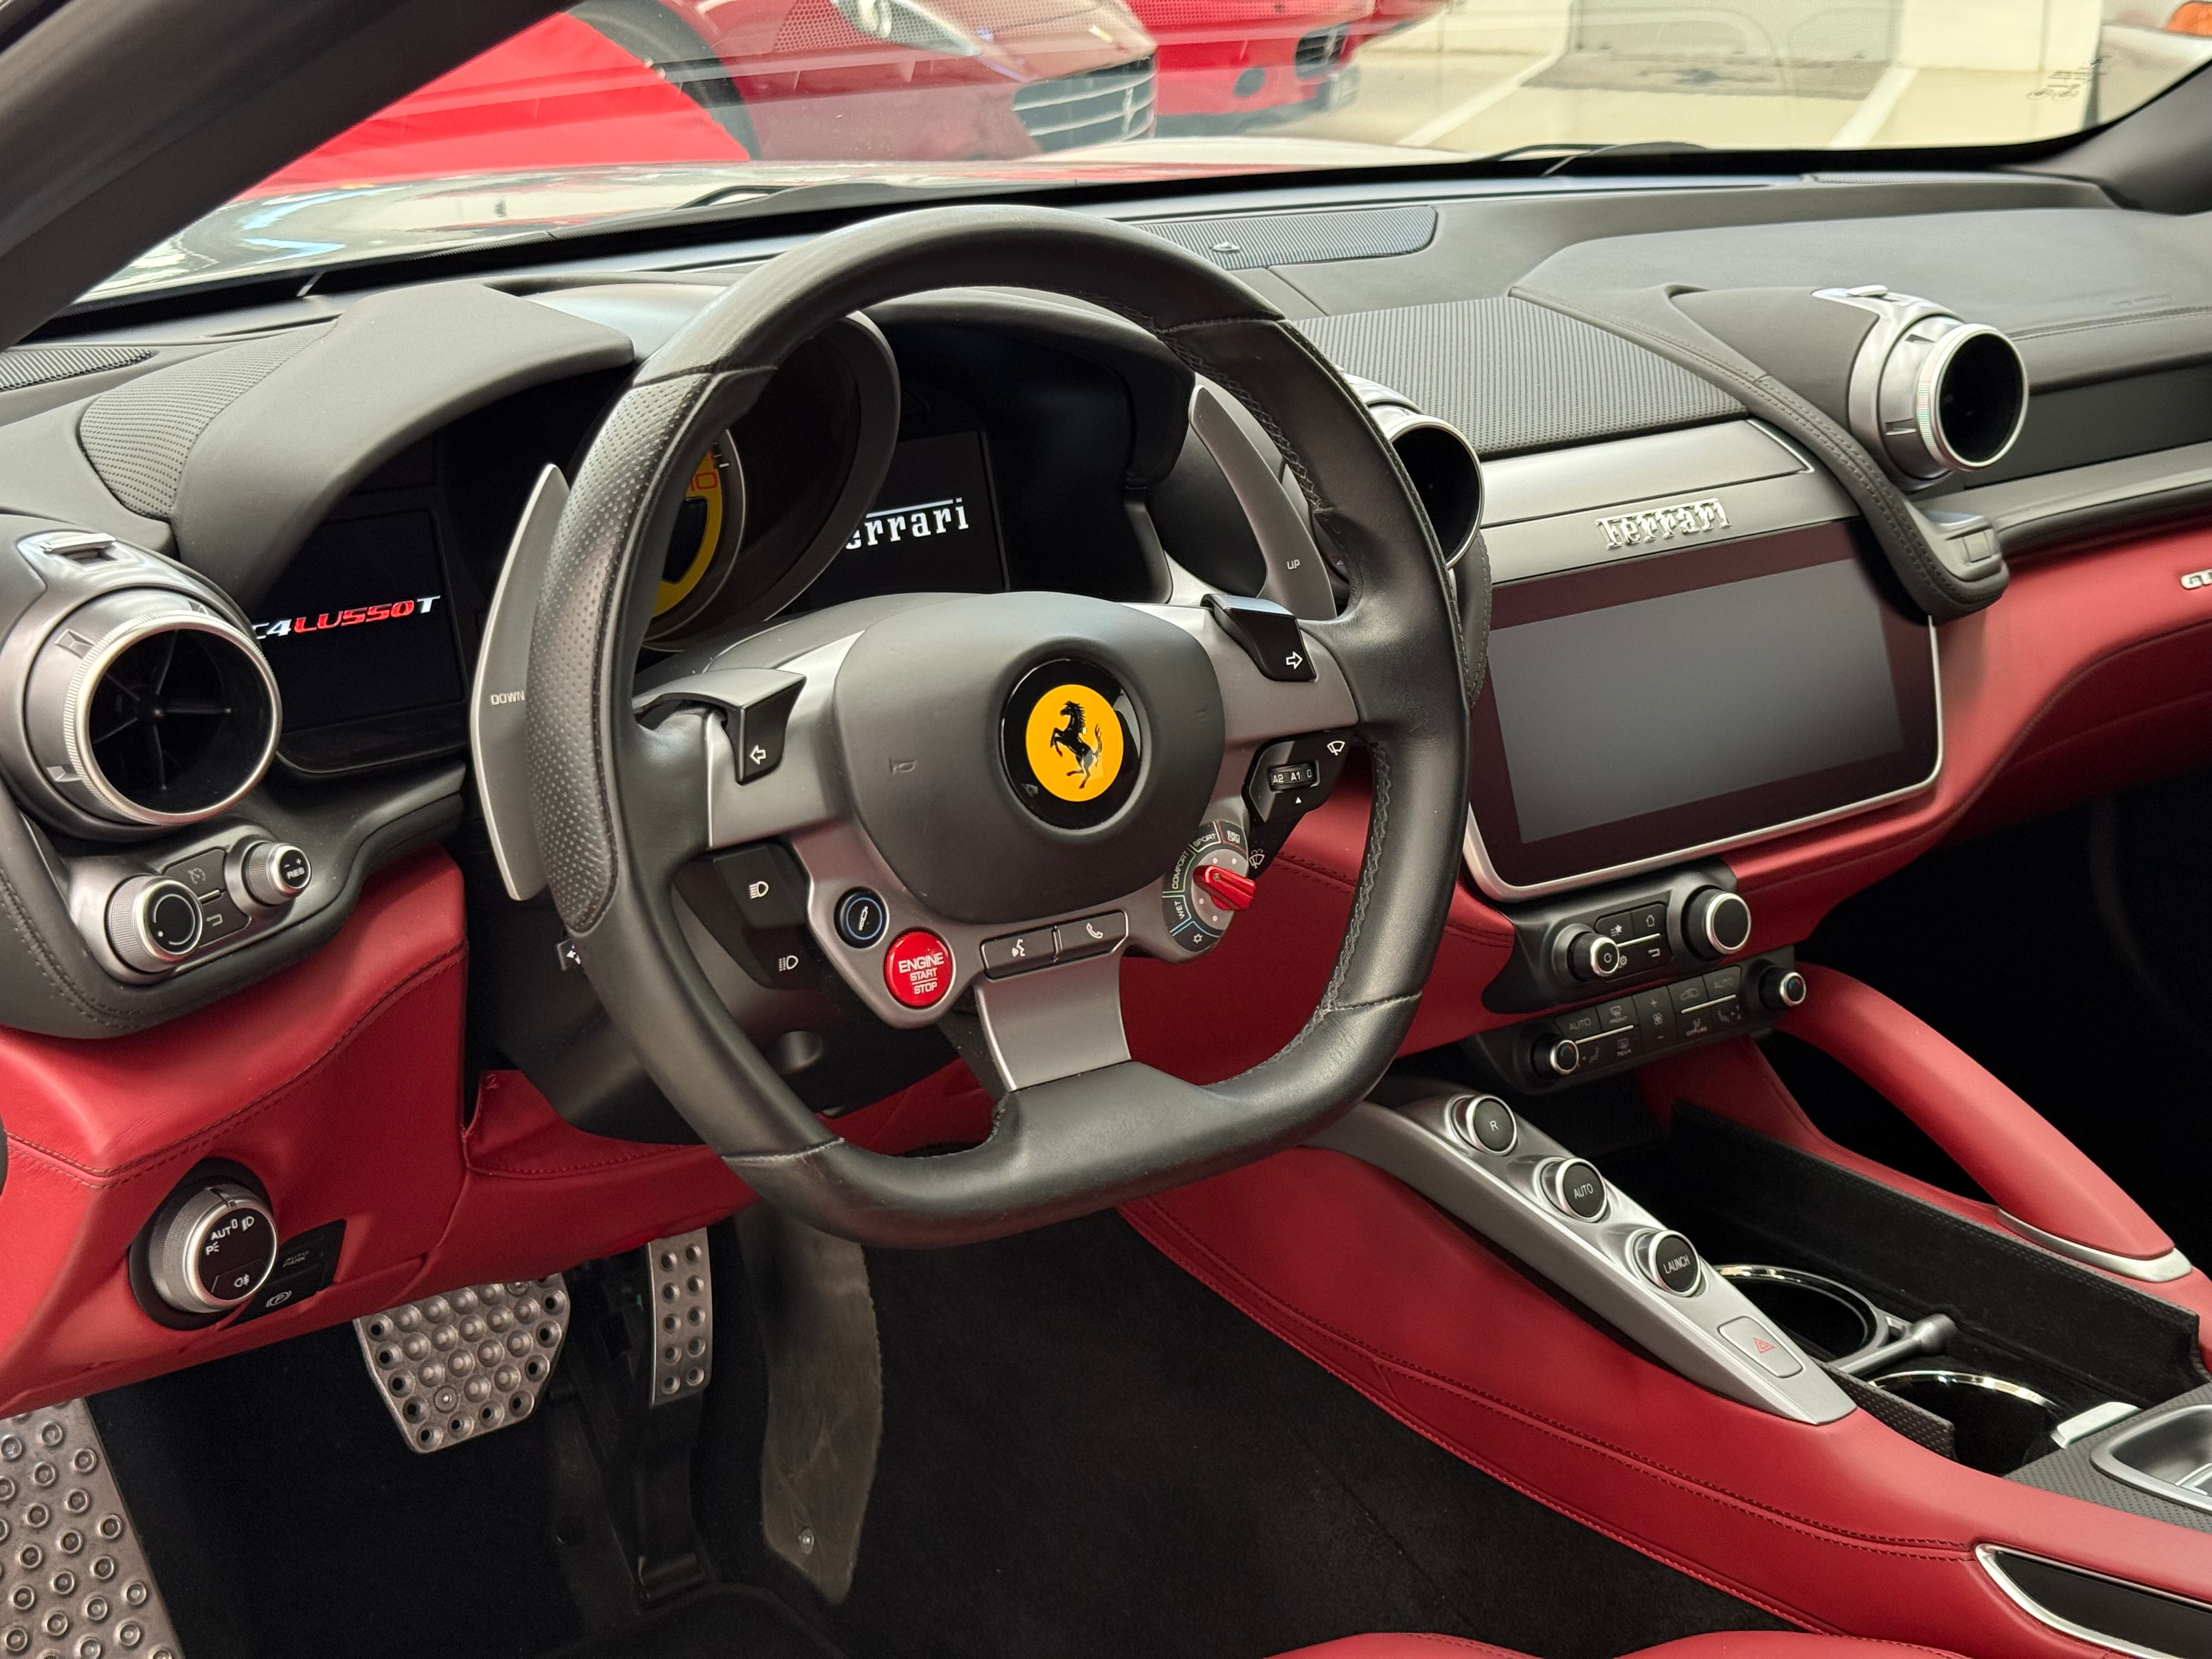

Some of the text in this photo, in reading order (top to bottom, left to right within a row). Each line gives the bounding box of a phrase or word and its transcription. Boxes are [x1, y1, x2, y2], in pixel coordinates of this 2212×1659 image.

[846, 498, 969, 549] errari
[1595, 498, 1733, 549] Ferrari
[1287, 559, 1300, 569] UP
[490, 690, 525, 705] DOWN
[1273, 774, 1284, 783] A2
[1291, 771, 1300, 781] A1
[1193, 833, 1216, 847] SPORT
[287, 867, 305, 880] RES
[1172, 850, 1189, 889] COMFORT
[1175, 900, 1185, 919] WET
[899, 952, 944, 974] ENGINE
[910, 967, 938, 981] START
[914, 981, 938, 995] STOP
[1569, 1018, 1591, 1030] AUTO
[1489, 1120, 1499, 1132] R
[1573, 1183, 1594, 1199] AUTO
[1663, 1254, 1691, 1274] LAUNCH
